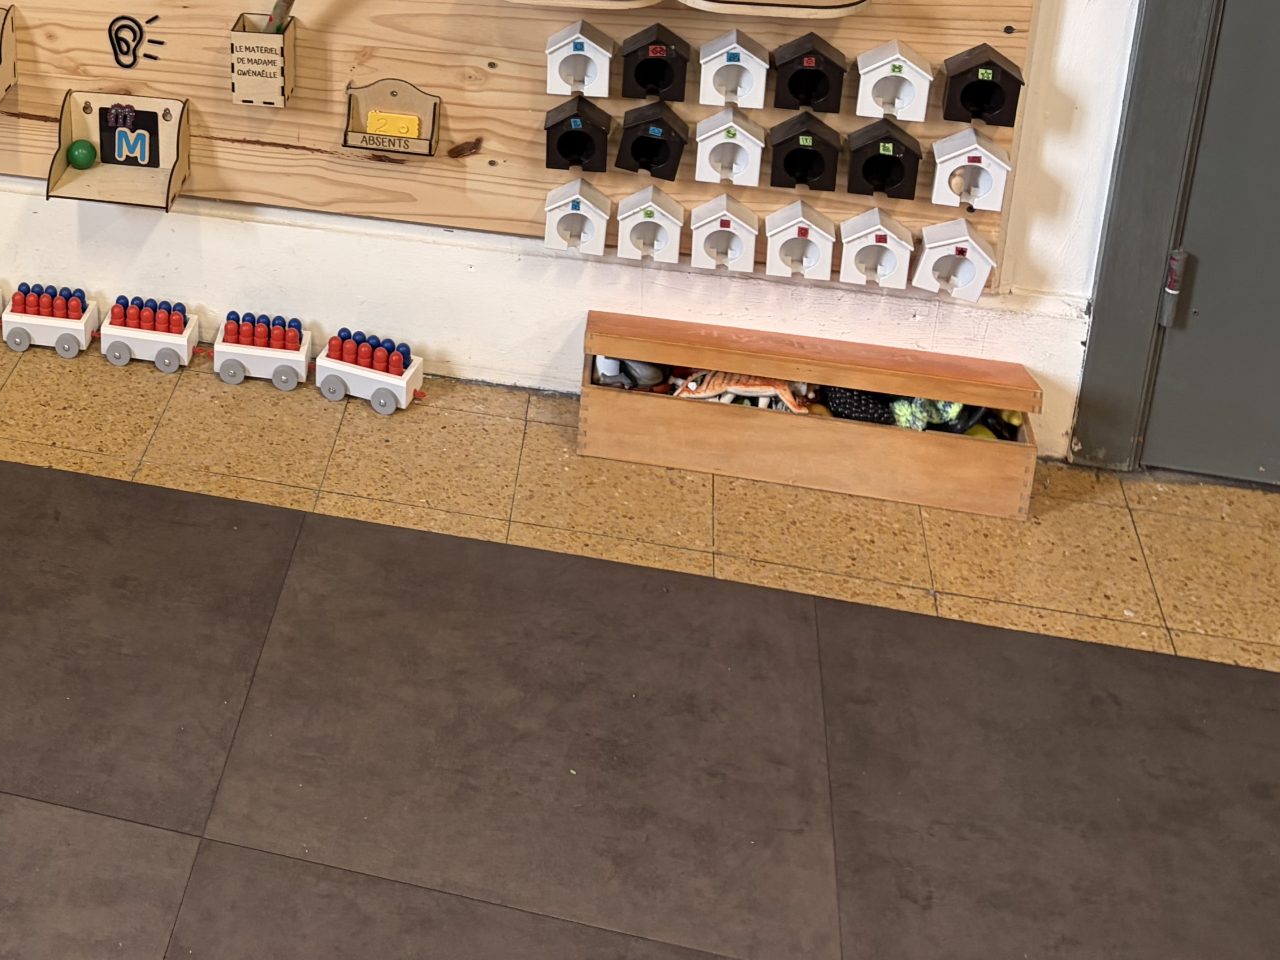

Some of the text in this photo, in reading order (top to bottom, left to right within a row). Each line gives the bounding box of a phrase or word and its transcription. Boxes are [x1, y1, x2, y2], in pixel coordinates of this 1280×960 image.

[235, 45, 243, 53] LE
[236, 57, 278, 67] DE MADAME
[114, 127, 151, 165] M
[360, 135, 411, 149] ABSENTS
